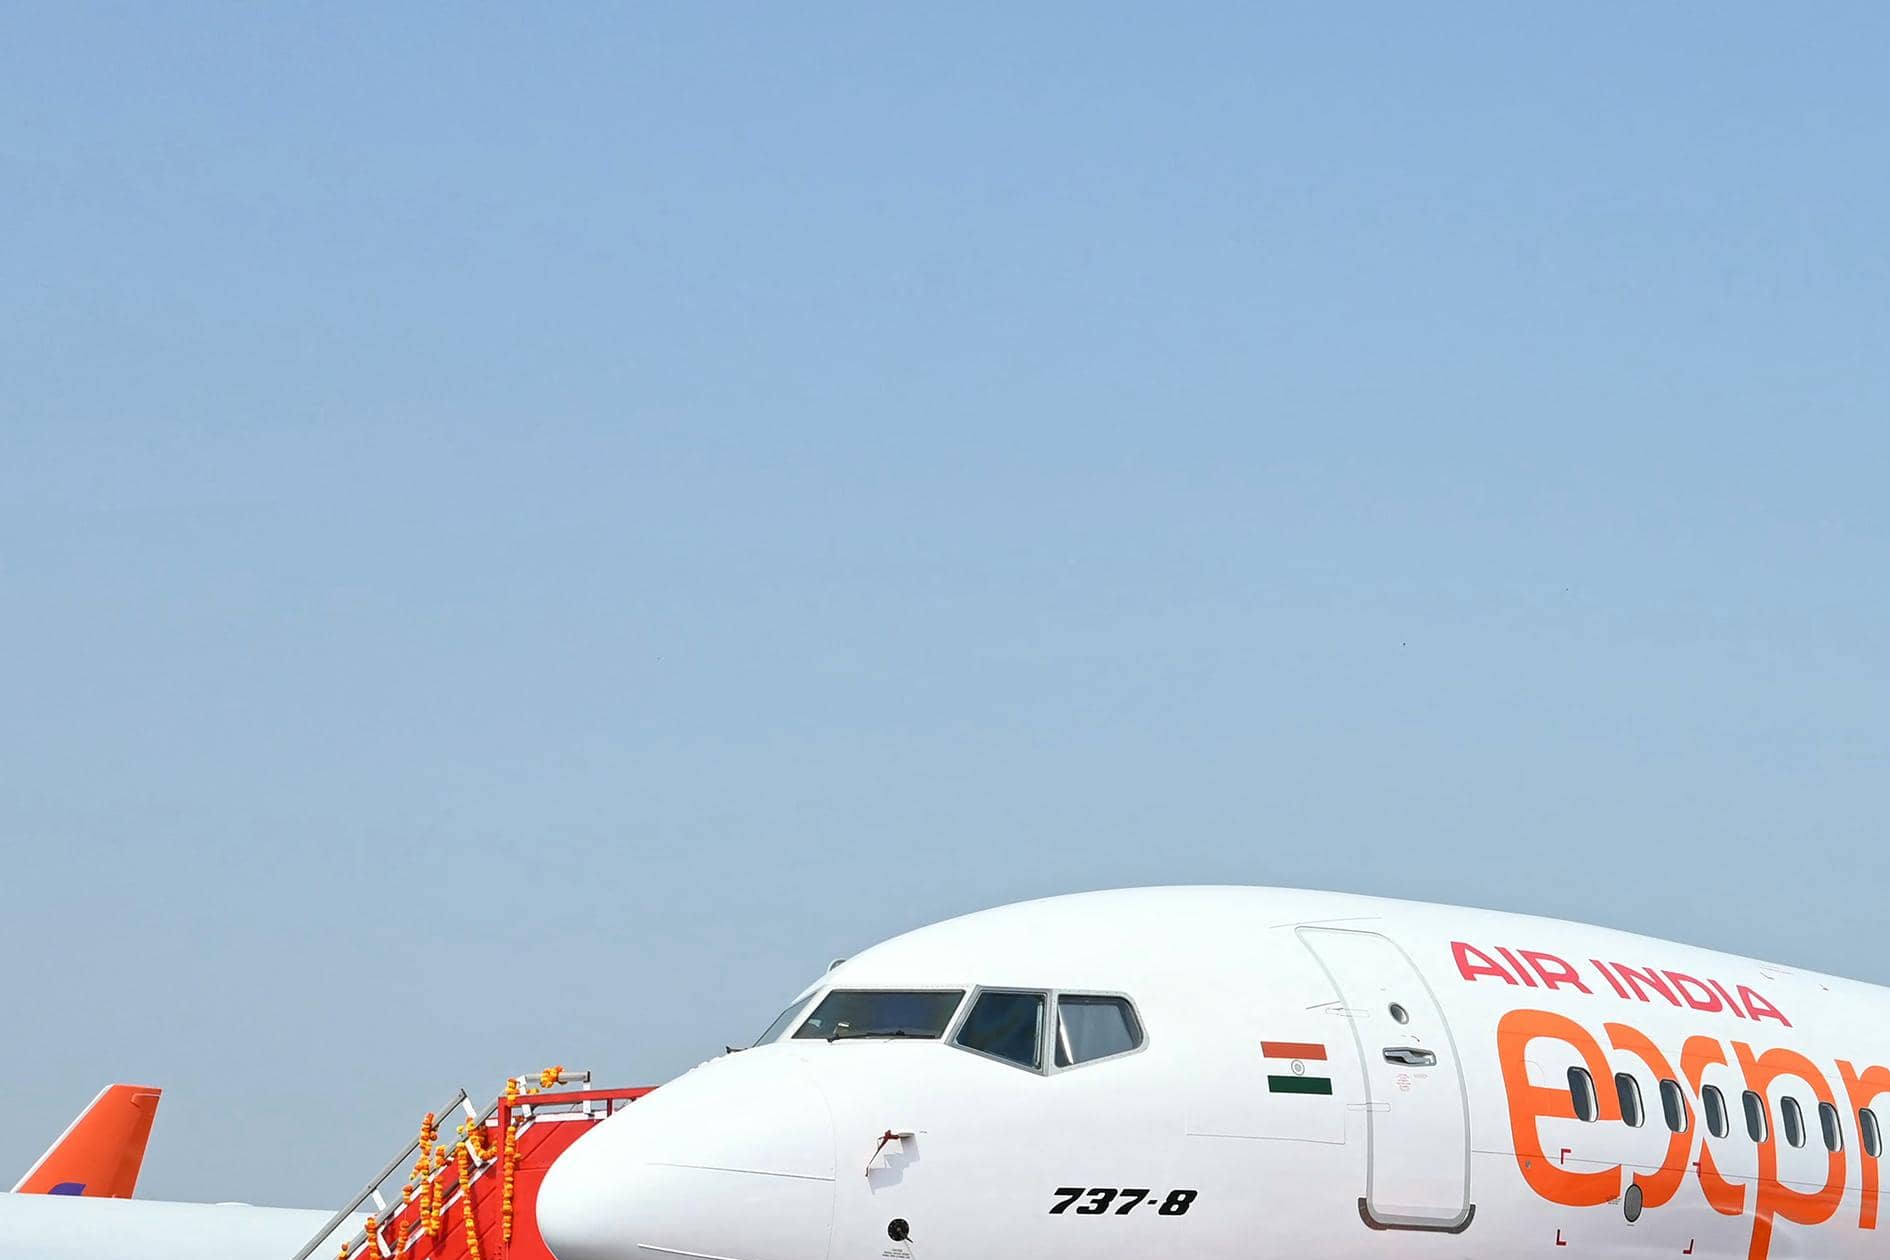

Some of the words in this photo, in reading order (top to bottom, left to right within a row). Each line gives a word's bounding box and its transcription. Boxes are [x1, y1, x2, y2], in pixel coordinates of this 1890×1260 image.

[1450, 941, 1593, 994] AIR
[1589, 958, 1793, 1028] INDIA
[1049, 1187, 1198, 1215] 737-8
